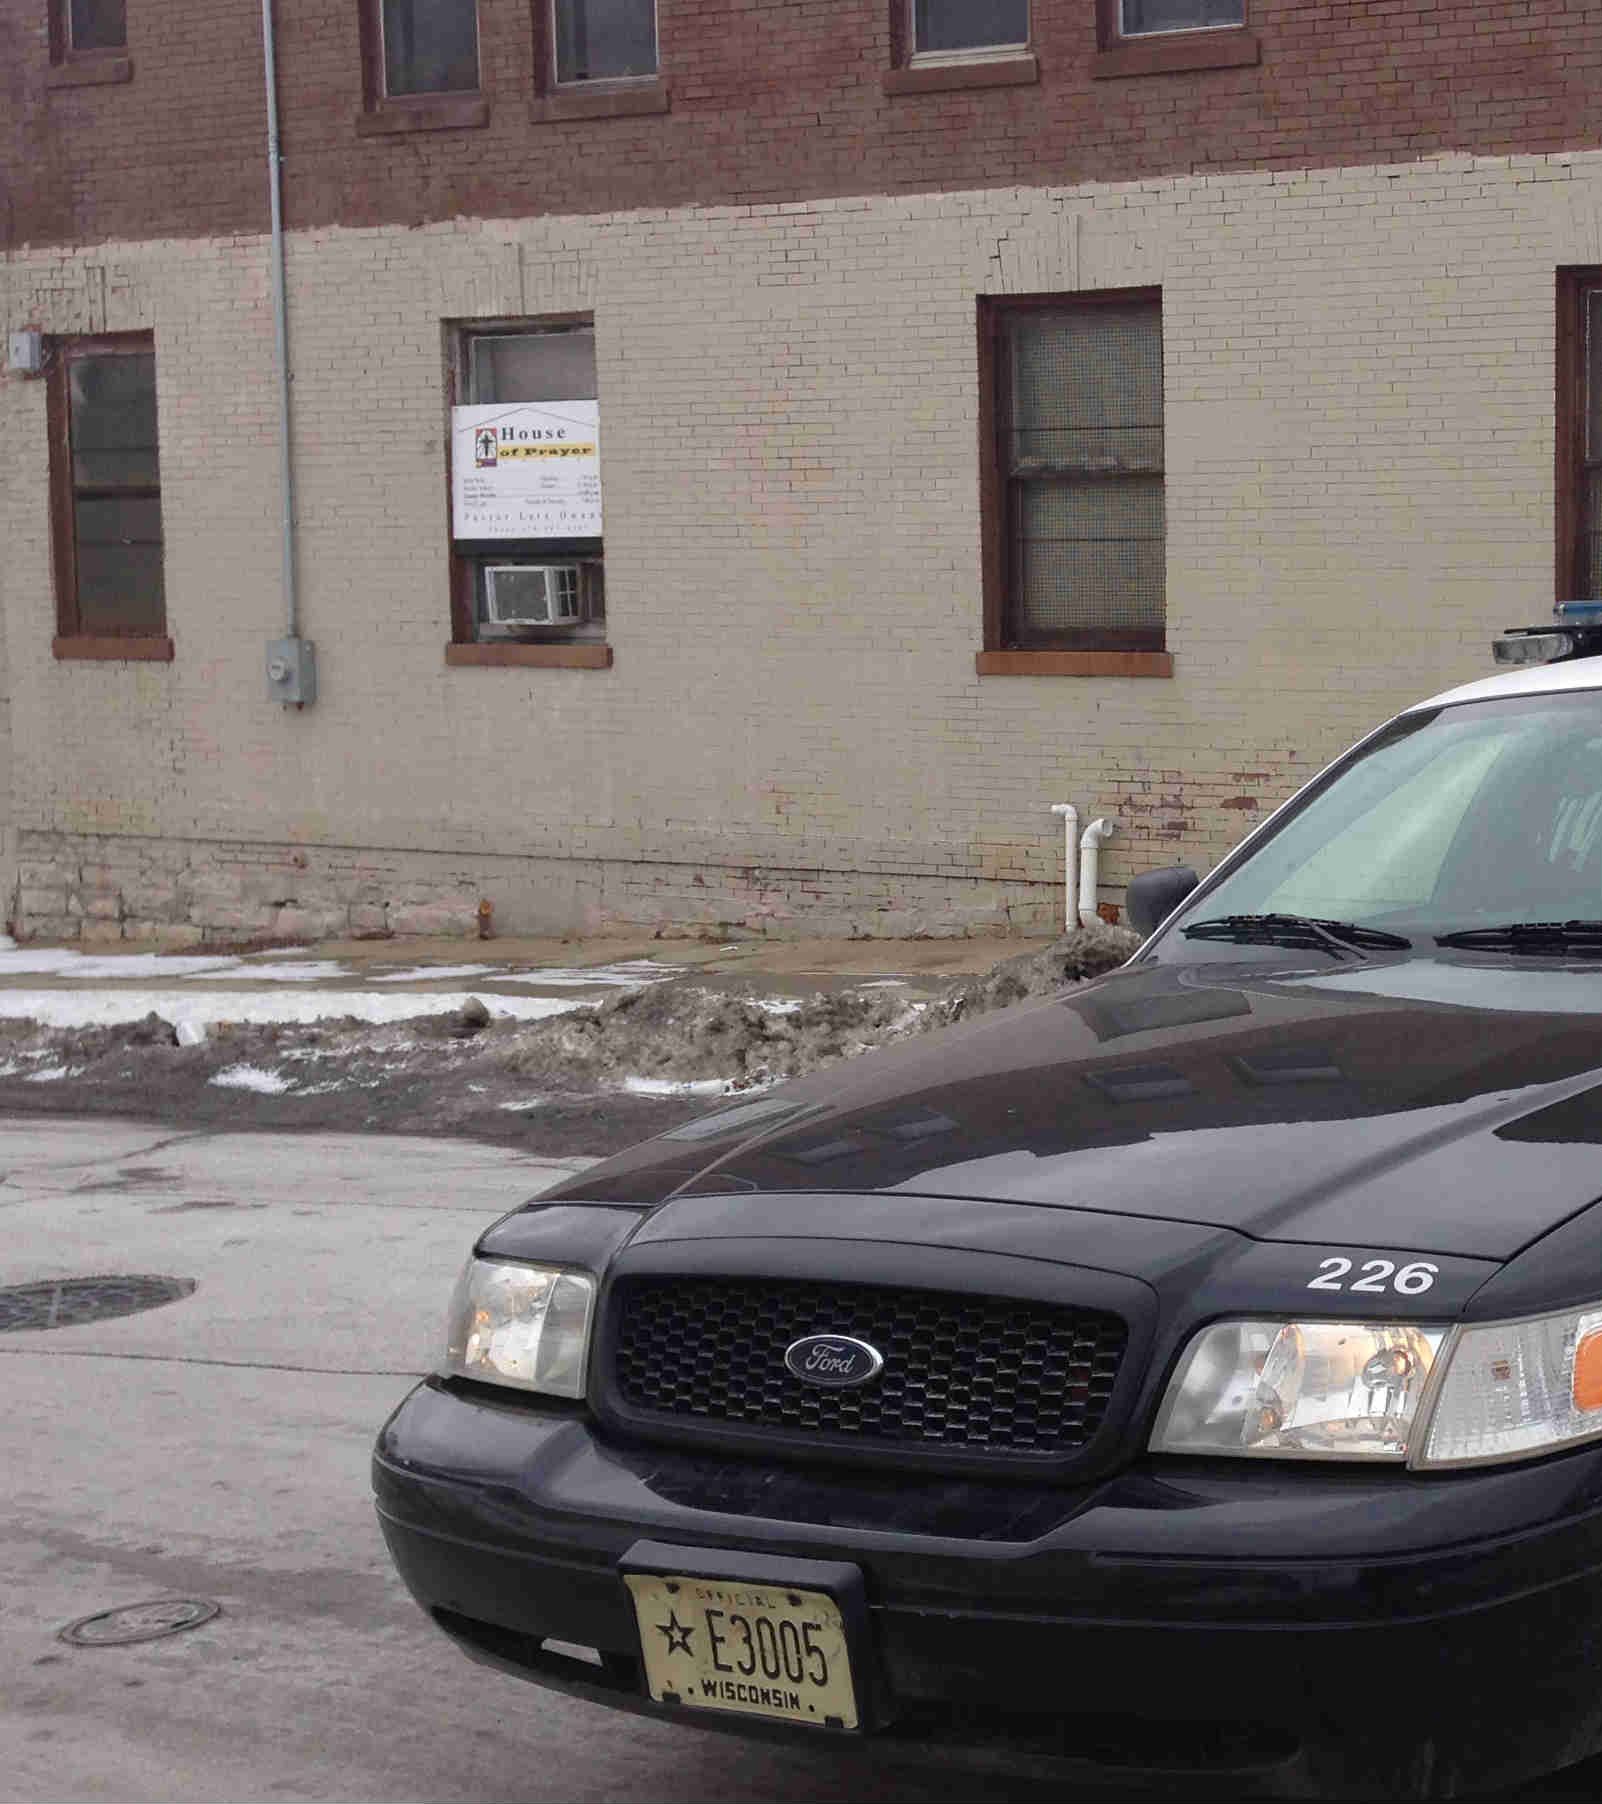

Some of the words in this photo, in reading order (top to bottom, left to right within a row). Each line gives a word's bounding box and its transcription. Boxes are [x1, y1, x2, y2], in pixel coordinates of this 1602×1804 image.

[501, 427, 568, 441] House
[499, 447, 520, 457] of
[523, 447, 592, 457] Prayer
[1306, 1257, 1440, 1295] 226
[805, 1343, 856, 1374] Ford
[704, 1608, 829, 1688] E3005
[701, 1679, 802, 1710] WISCONSIN
